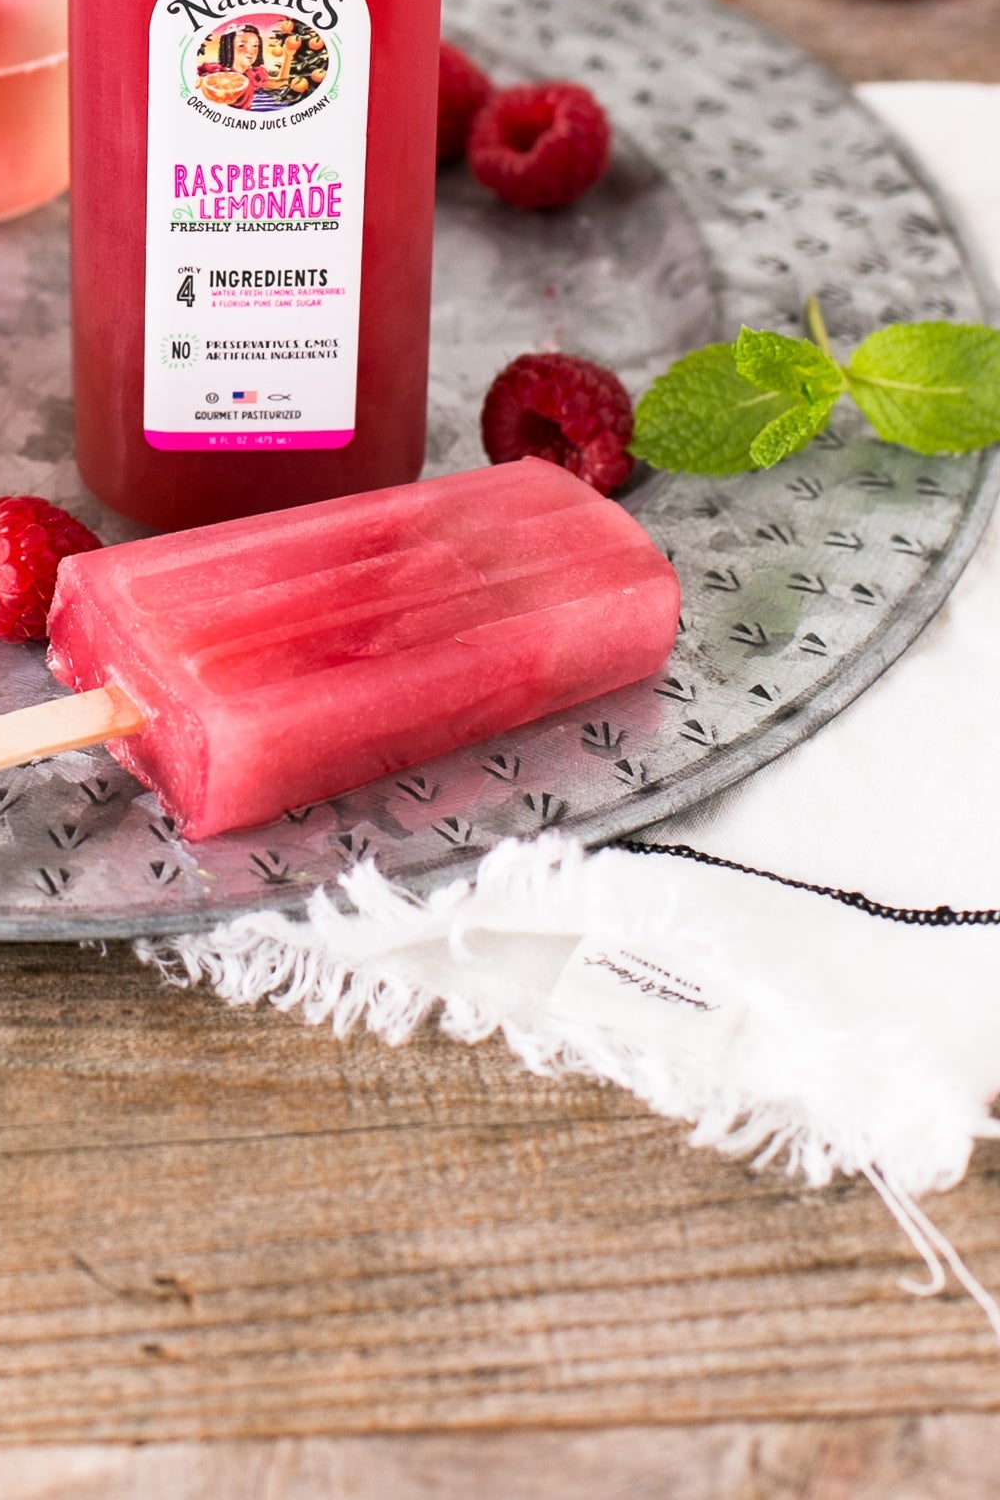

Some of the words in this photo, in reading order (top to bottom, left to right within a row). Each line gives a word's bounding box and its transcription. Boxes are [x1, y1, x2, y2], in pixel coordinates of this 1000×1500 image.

[186, 96, 222, 123] ORCHID
[222, 116, 257, 130] ISLAND
[259, 117, 287, 130] JUICE
[290, 95, 331, 125] COMPANY
[174, 163, 319, 198] RASPBERRY
[200, 183, 342, 219] LEMONADE
[170, 222, 232, 232] FRESHLY
[236, 221, 339, 232] HANDCRAFTED
[177, 266, 201, 274] ONLY
[209, 269, 328, 287] INGREDIENTS
[176, 275, 195, 307] 4
[296, 299, 322, 307] SUGAR
[172, 341, 191, 360] NO
[205, 352, 267, 360] ARTIFICIAL
[270, 350, 338, 360] INGREDIENTS
[194, 411, 238, 420] GOURMET
[241, 410, 302, 420] PASTEURIZED
[620, 950, 671, 978] MAGNOLIA
[675, 977, 701, 992] WITH
